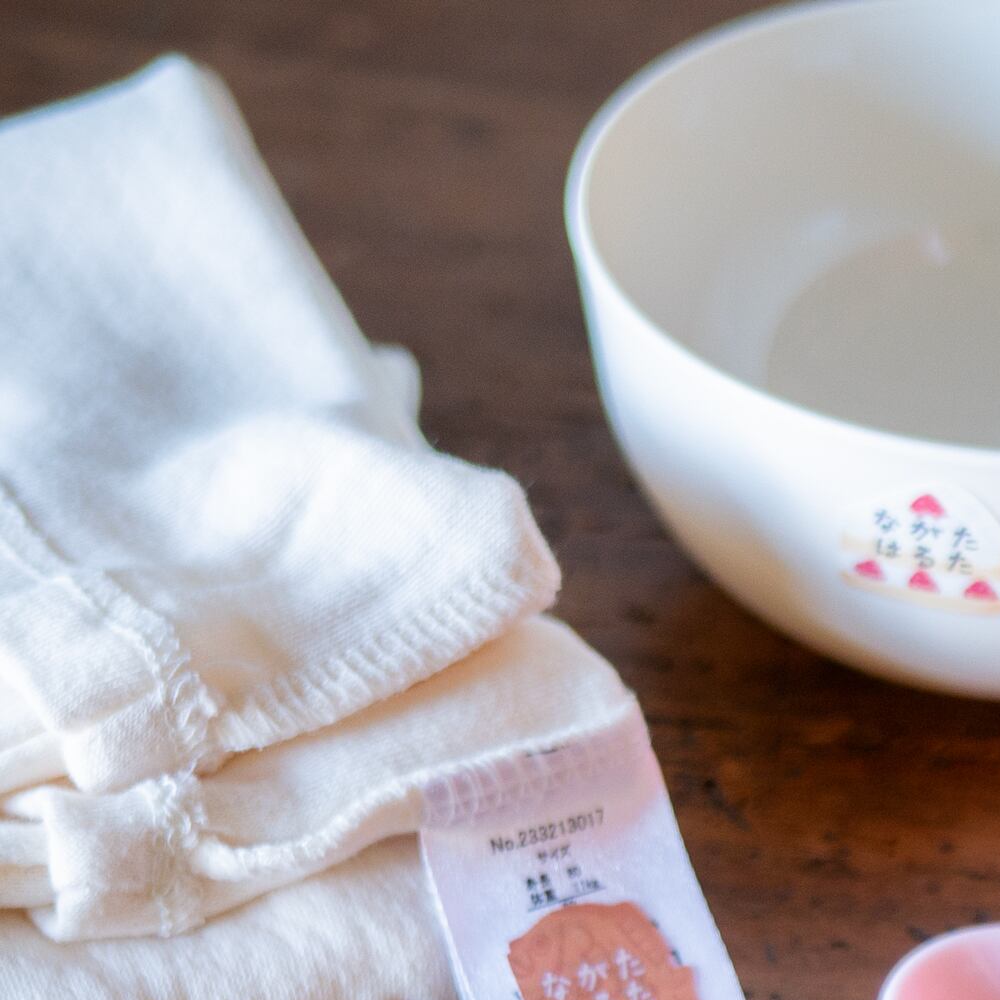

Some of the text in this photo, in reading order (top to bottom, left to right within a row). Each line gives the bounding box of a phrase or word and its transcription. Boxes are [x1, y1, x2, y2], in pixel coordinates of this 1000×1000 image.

[874, 510, 977, 550] ながた
[876, 539, 972, 575] はるた
[490, 808, 604, 854] No.233213017
